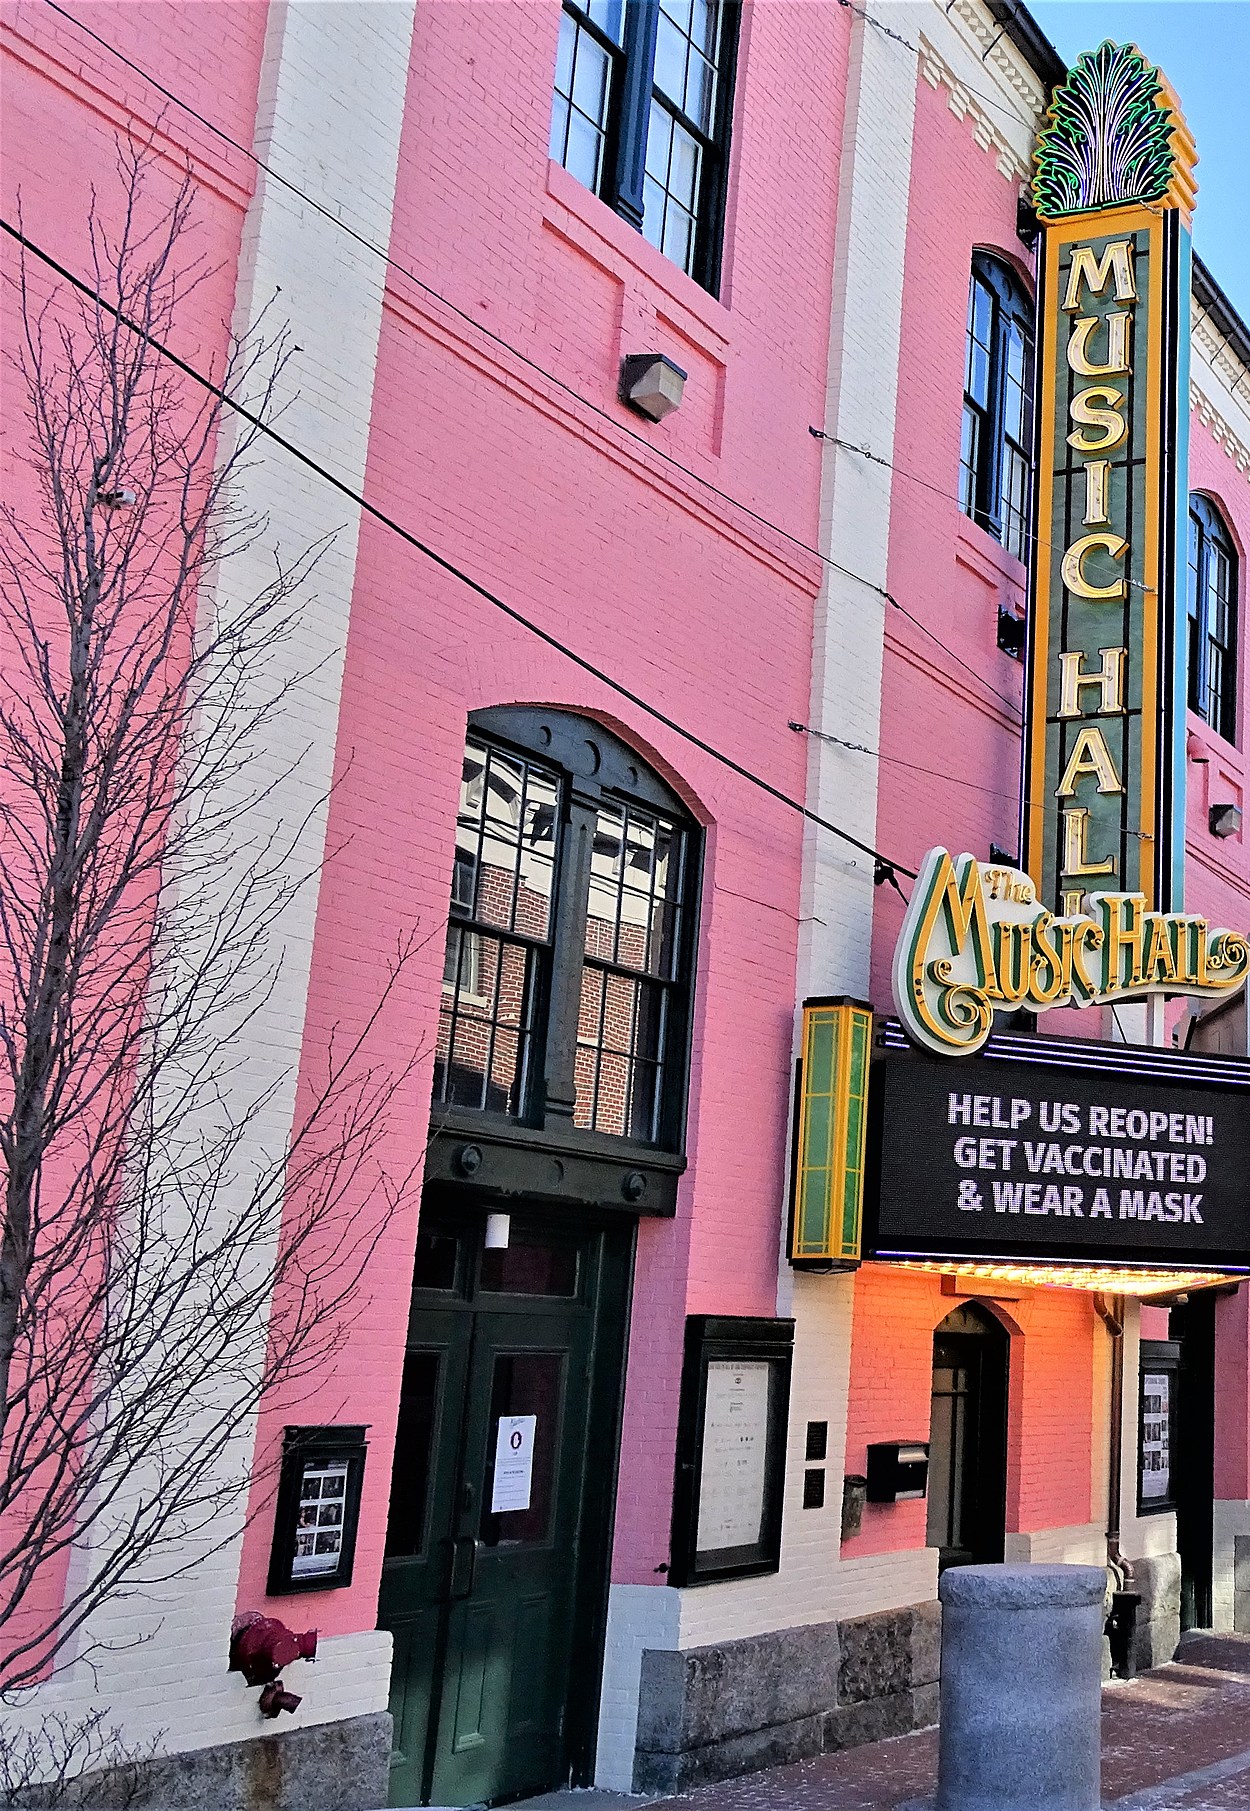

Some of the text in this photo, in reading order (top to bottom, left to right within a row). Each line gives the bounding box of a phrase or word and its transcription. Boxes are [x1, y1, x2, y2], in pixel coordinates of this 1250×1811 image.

[1060, 238, 1138, 601] MUSIC
[984, 870, 1034, 904] The
[948, 1092, 1214, 1145] HELP US REOPEN!
[953, 1136, 1207, 1184] GET VACCINATED
[957, 1179, 1204, 1224] & WEAR A MASK
